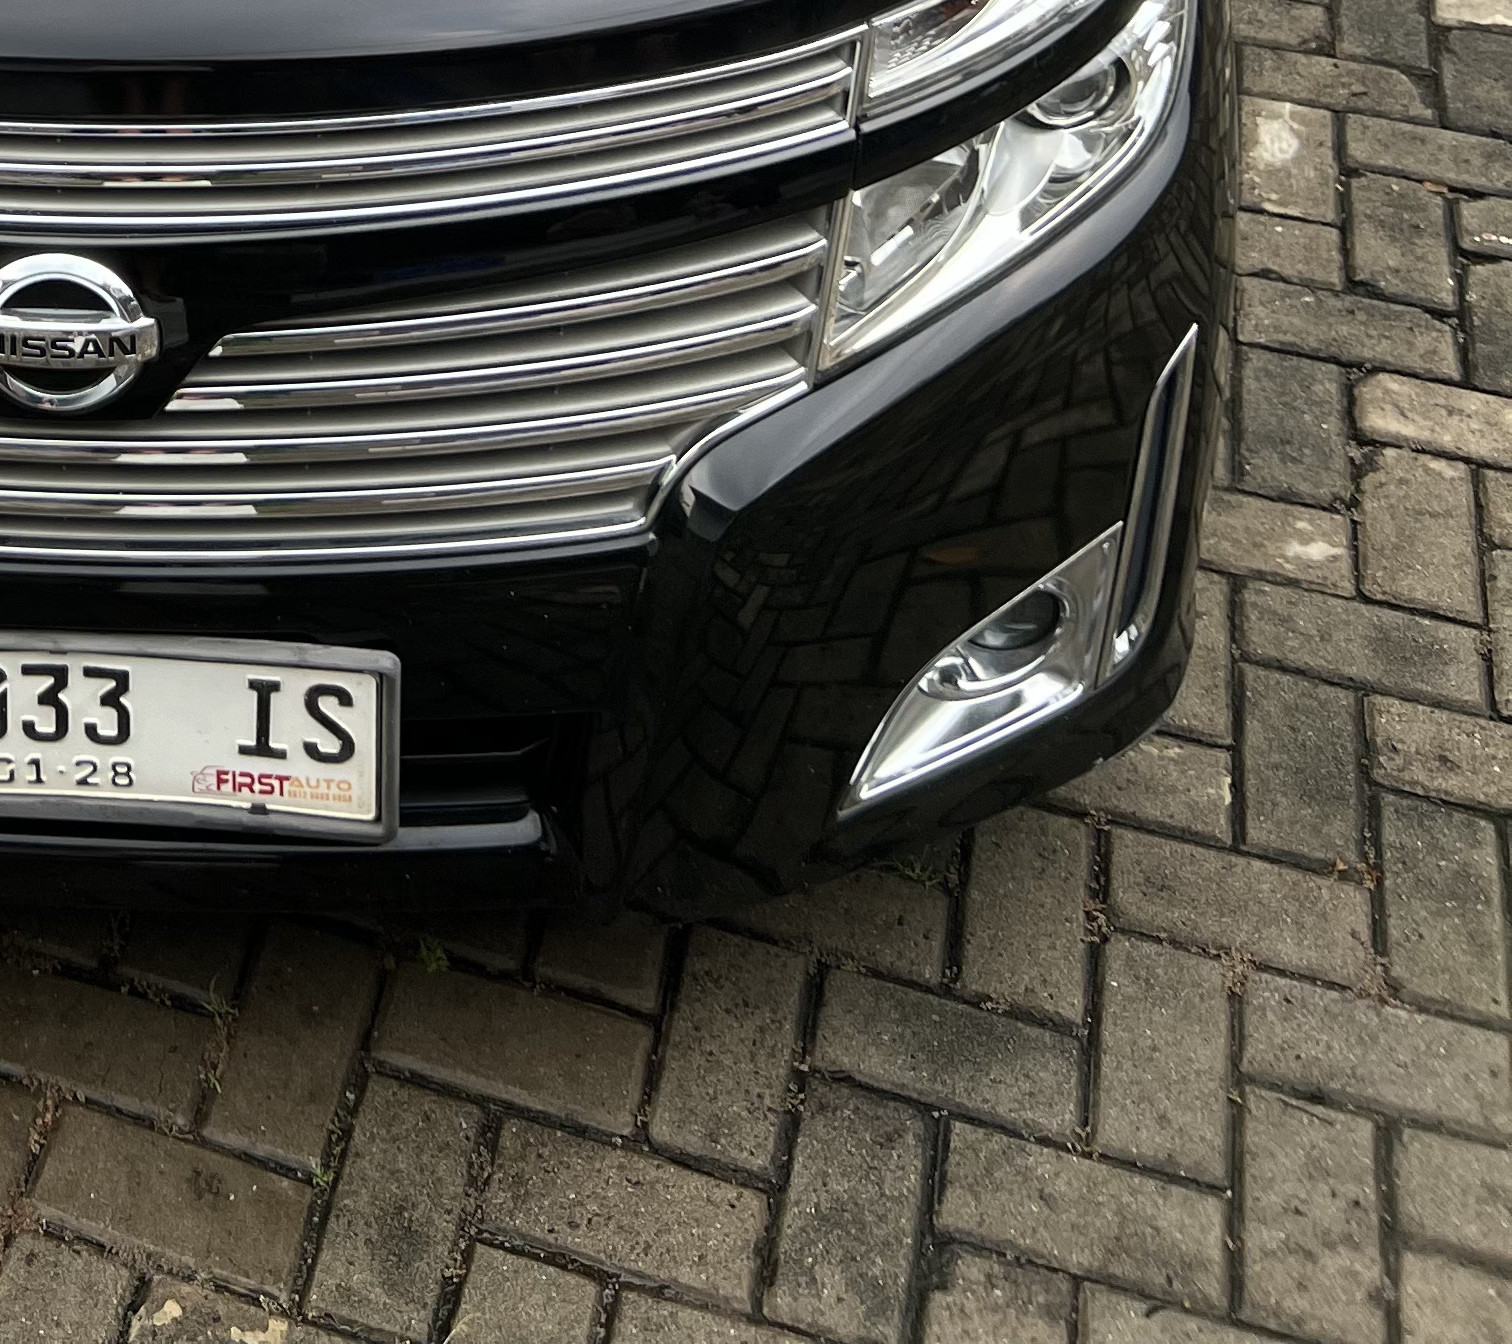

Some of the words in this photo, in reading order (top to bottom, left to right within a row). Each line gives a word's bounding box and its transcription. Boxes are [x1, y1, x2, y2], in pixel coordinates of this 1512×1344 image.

[237, 678, 355, 764] IS
[216, 769, 291, 797] FIRST
[288, 776, 353, 792] AUTO
